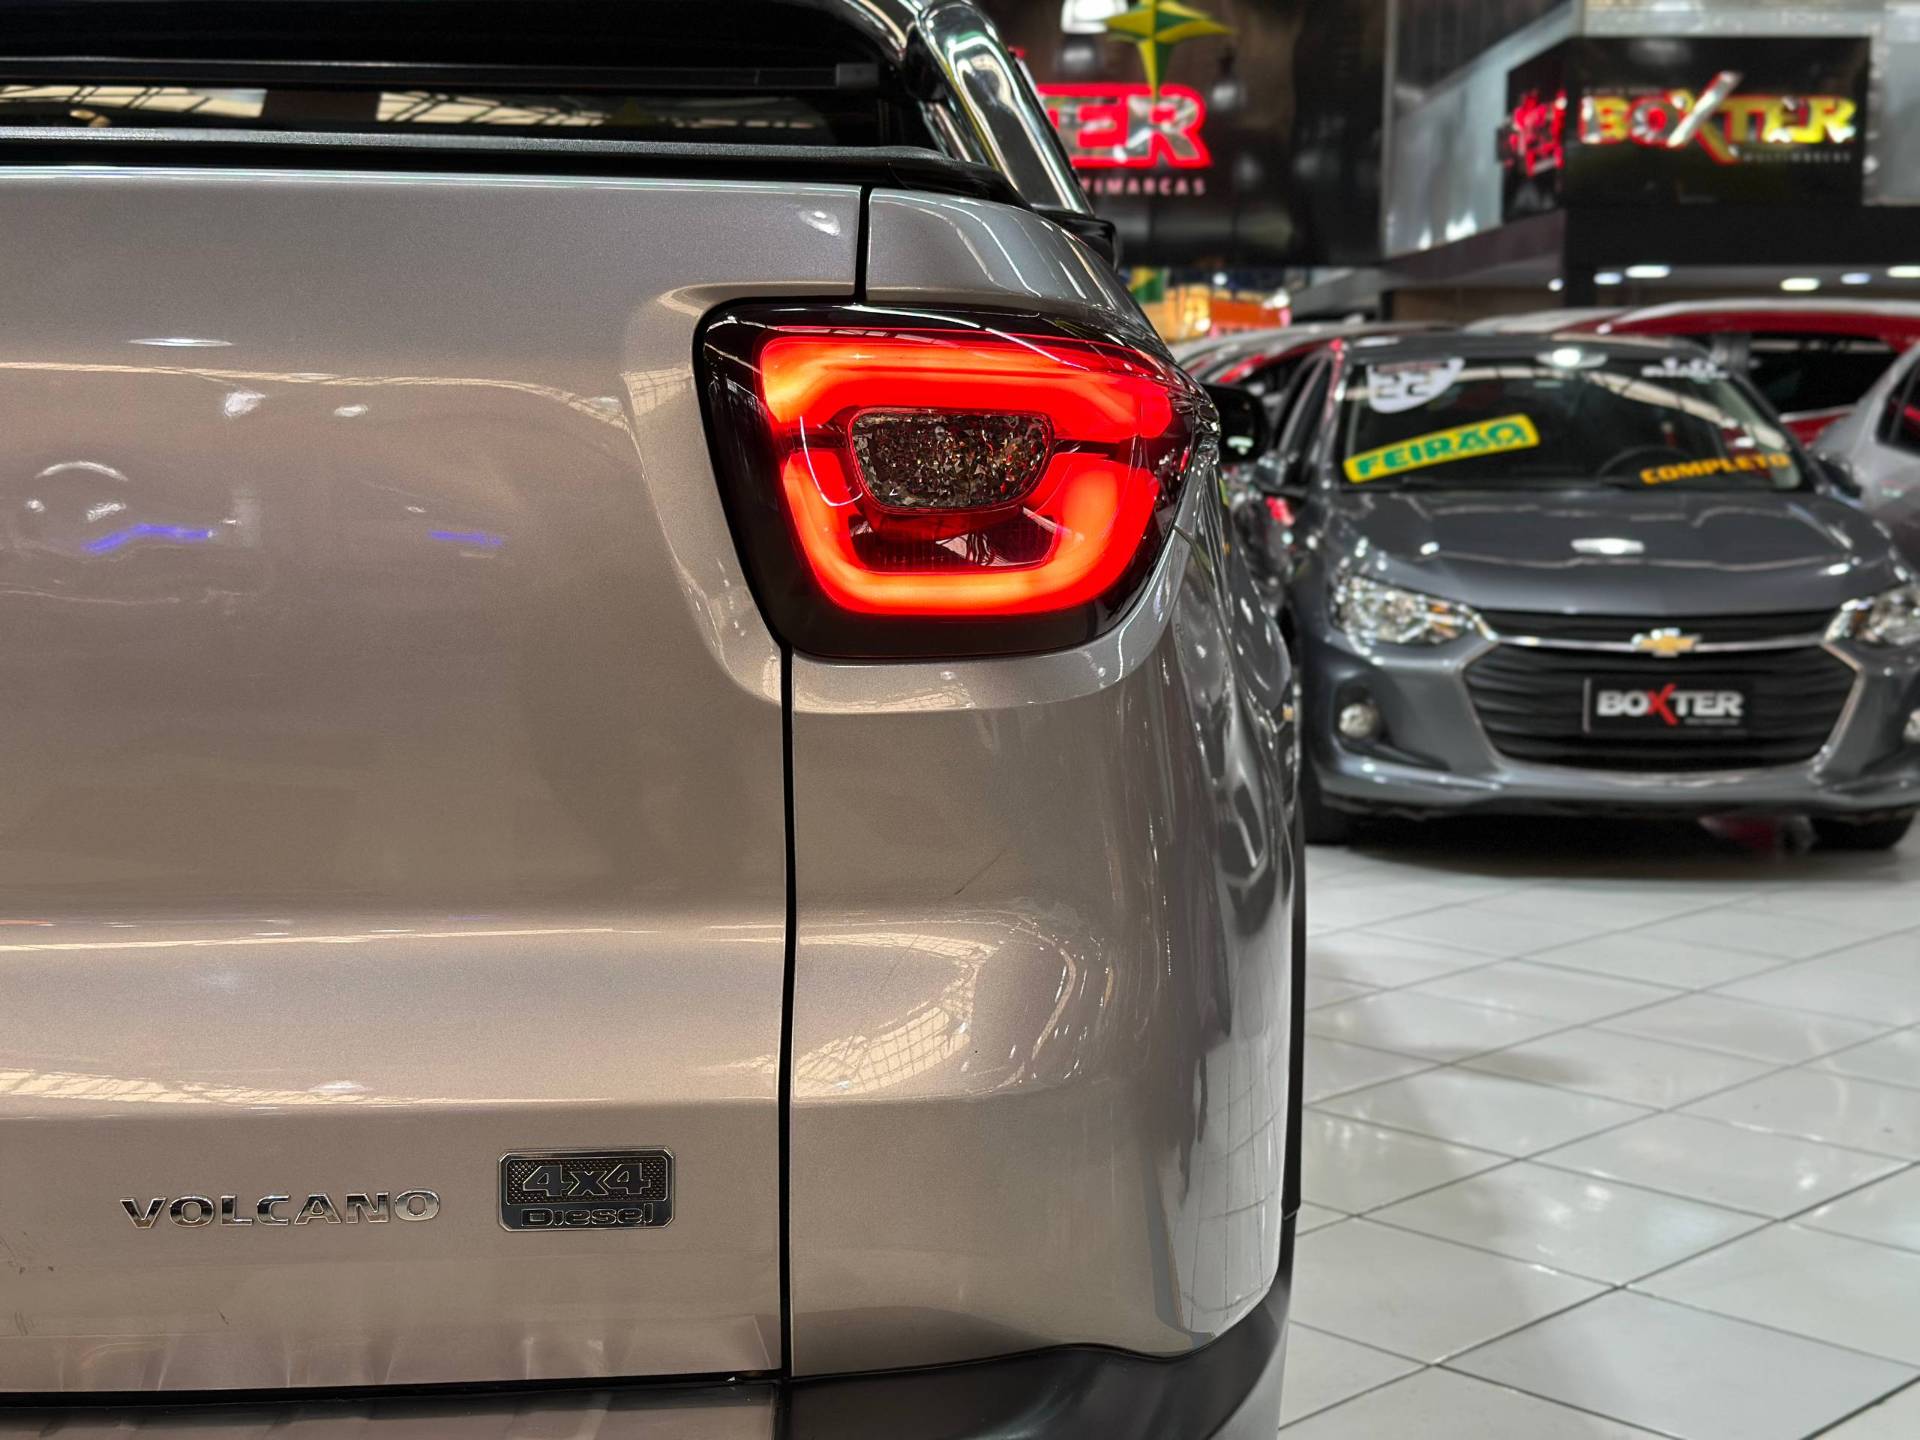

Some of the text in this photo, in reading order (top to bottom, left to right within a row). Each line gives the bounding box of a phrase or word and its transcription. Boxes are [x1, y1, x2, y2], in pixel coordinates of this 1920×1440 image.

[1579, 71, 1856, 165] BOXTER
[1355, 422, 1528, 477] FEIRÃO
[1640, 453, 1792, 485] COMPLETO
[1596, 683, 1744, 725] BOXTER
[522, 1162, 652, 1197] 4x4
[120, 1189, 441, 1230] VOLCANO
[520, 1202, 654, 1227] Diesel
